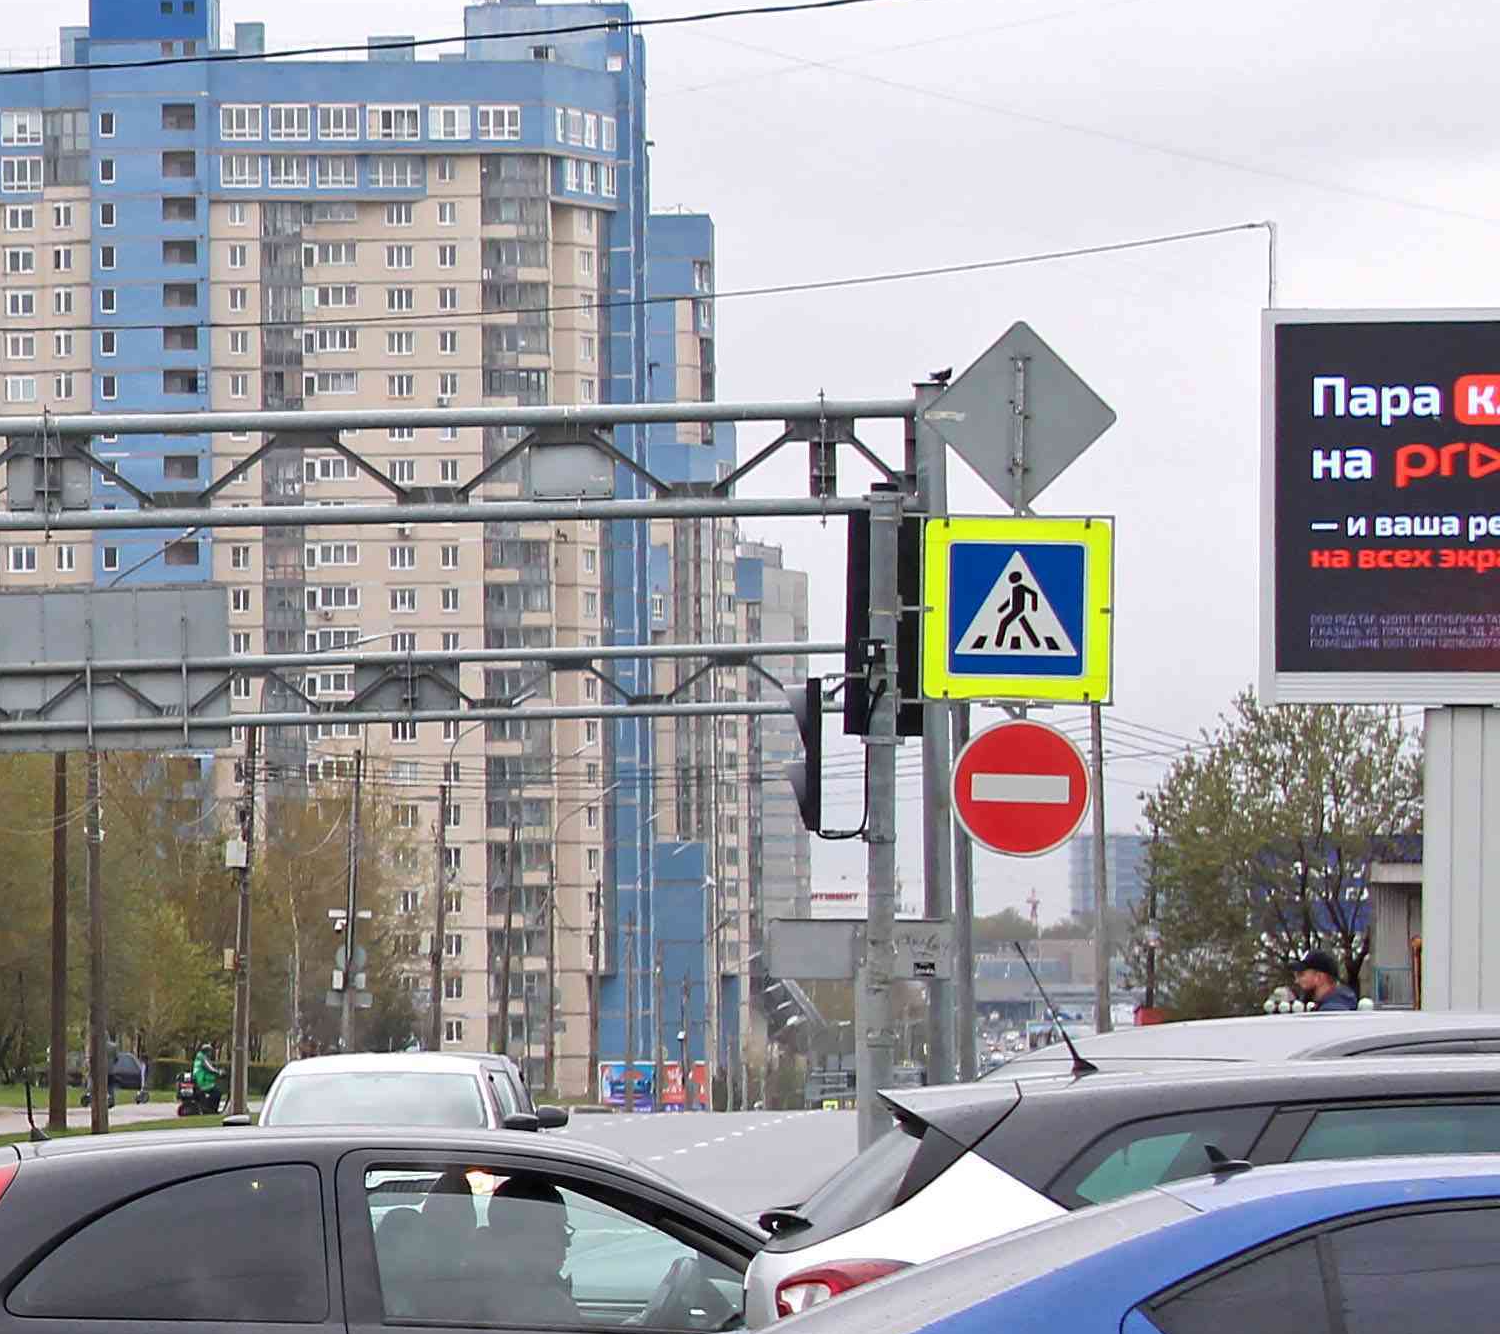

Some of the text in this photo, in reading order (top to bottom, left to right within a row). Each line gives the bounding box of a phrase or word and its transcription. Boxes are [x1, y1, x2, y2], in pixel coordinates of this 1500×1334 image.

[1313, 377, 1500, 426] Пара к
[1312, 449, 1372, 479] на
[1347, 516, 1367, 536] и
[1375, 516, 1460, 536] ваша
[1311, 549, 1351, 569] на
[1358, 549, 1432, 569] всех
